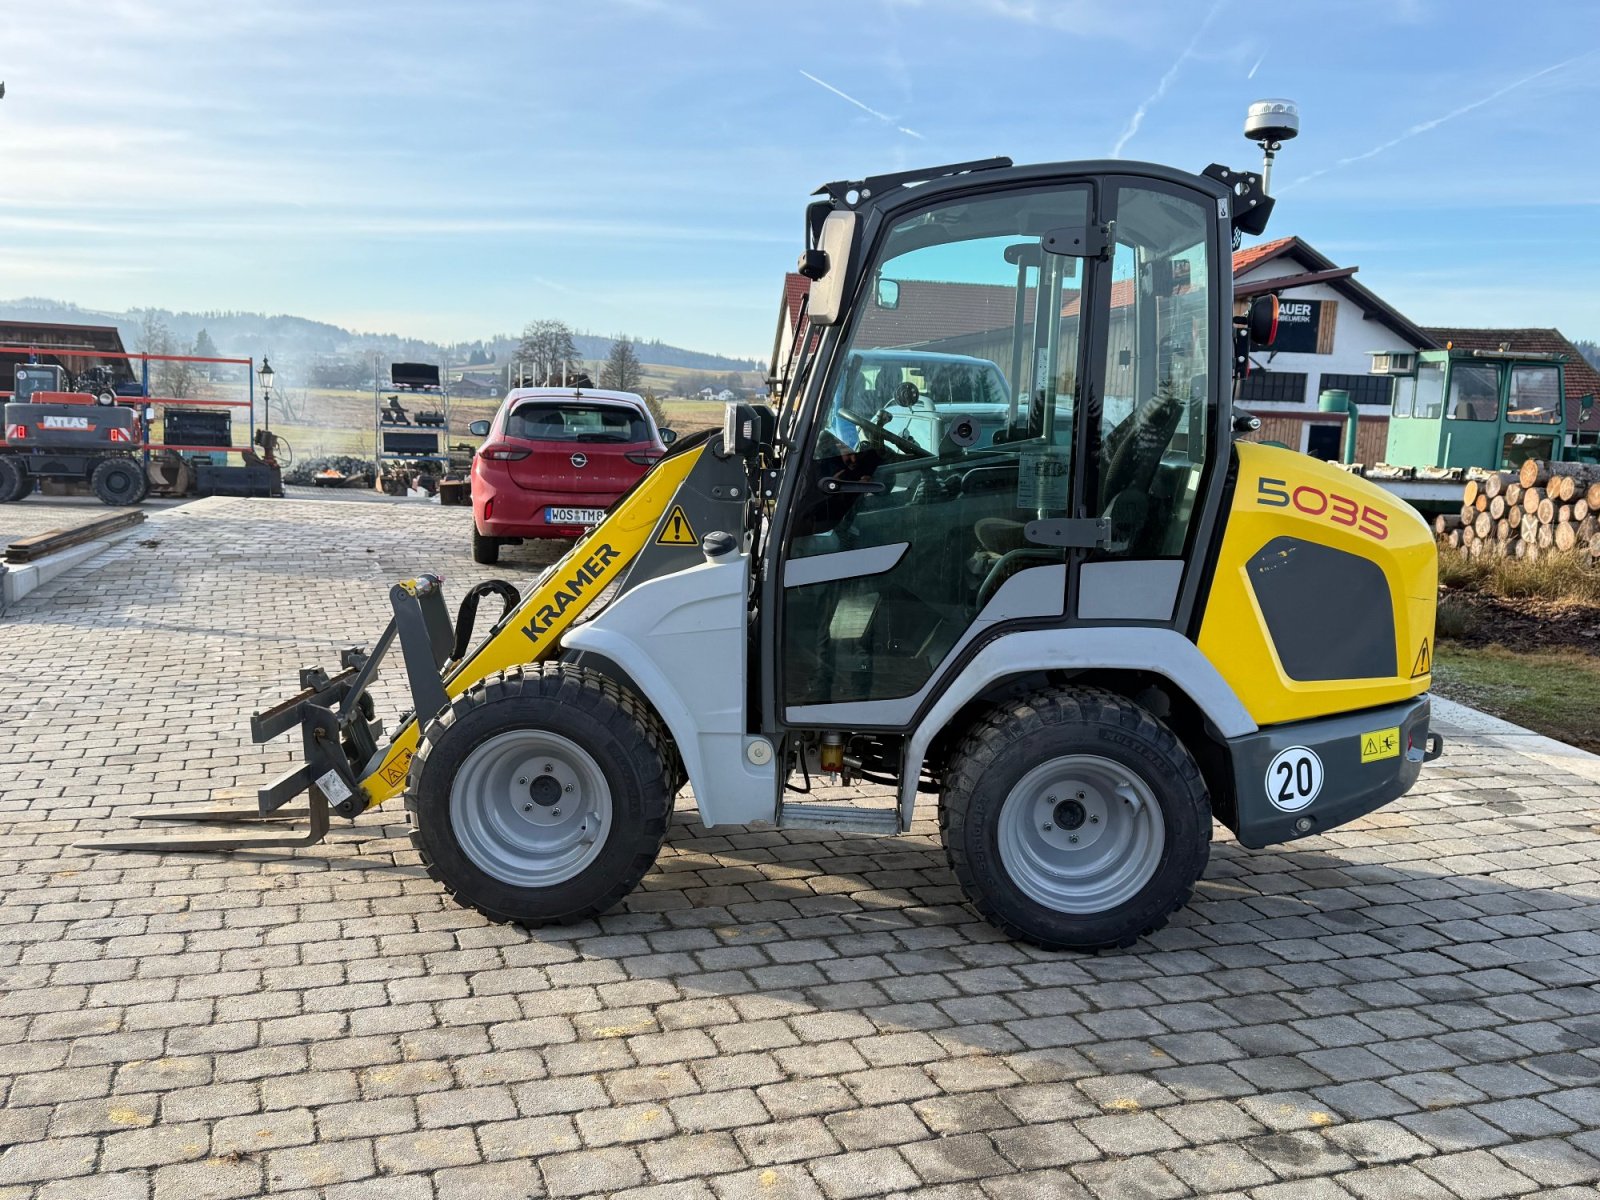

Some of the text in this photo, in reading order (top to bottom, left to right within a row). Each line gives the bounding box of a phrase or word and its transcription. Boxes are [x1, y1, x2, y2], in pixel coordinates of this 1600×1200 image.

[1279, 303, 1311, 315] AUER
[45, 416, 88, 428] ATLAS
[552, 509, 573, 520] WOS
[1257, 476, 1389, 541] 5035
[521, 543, 622, 643] KRAMER
[1276, 756, 1314, 802] 20
